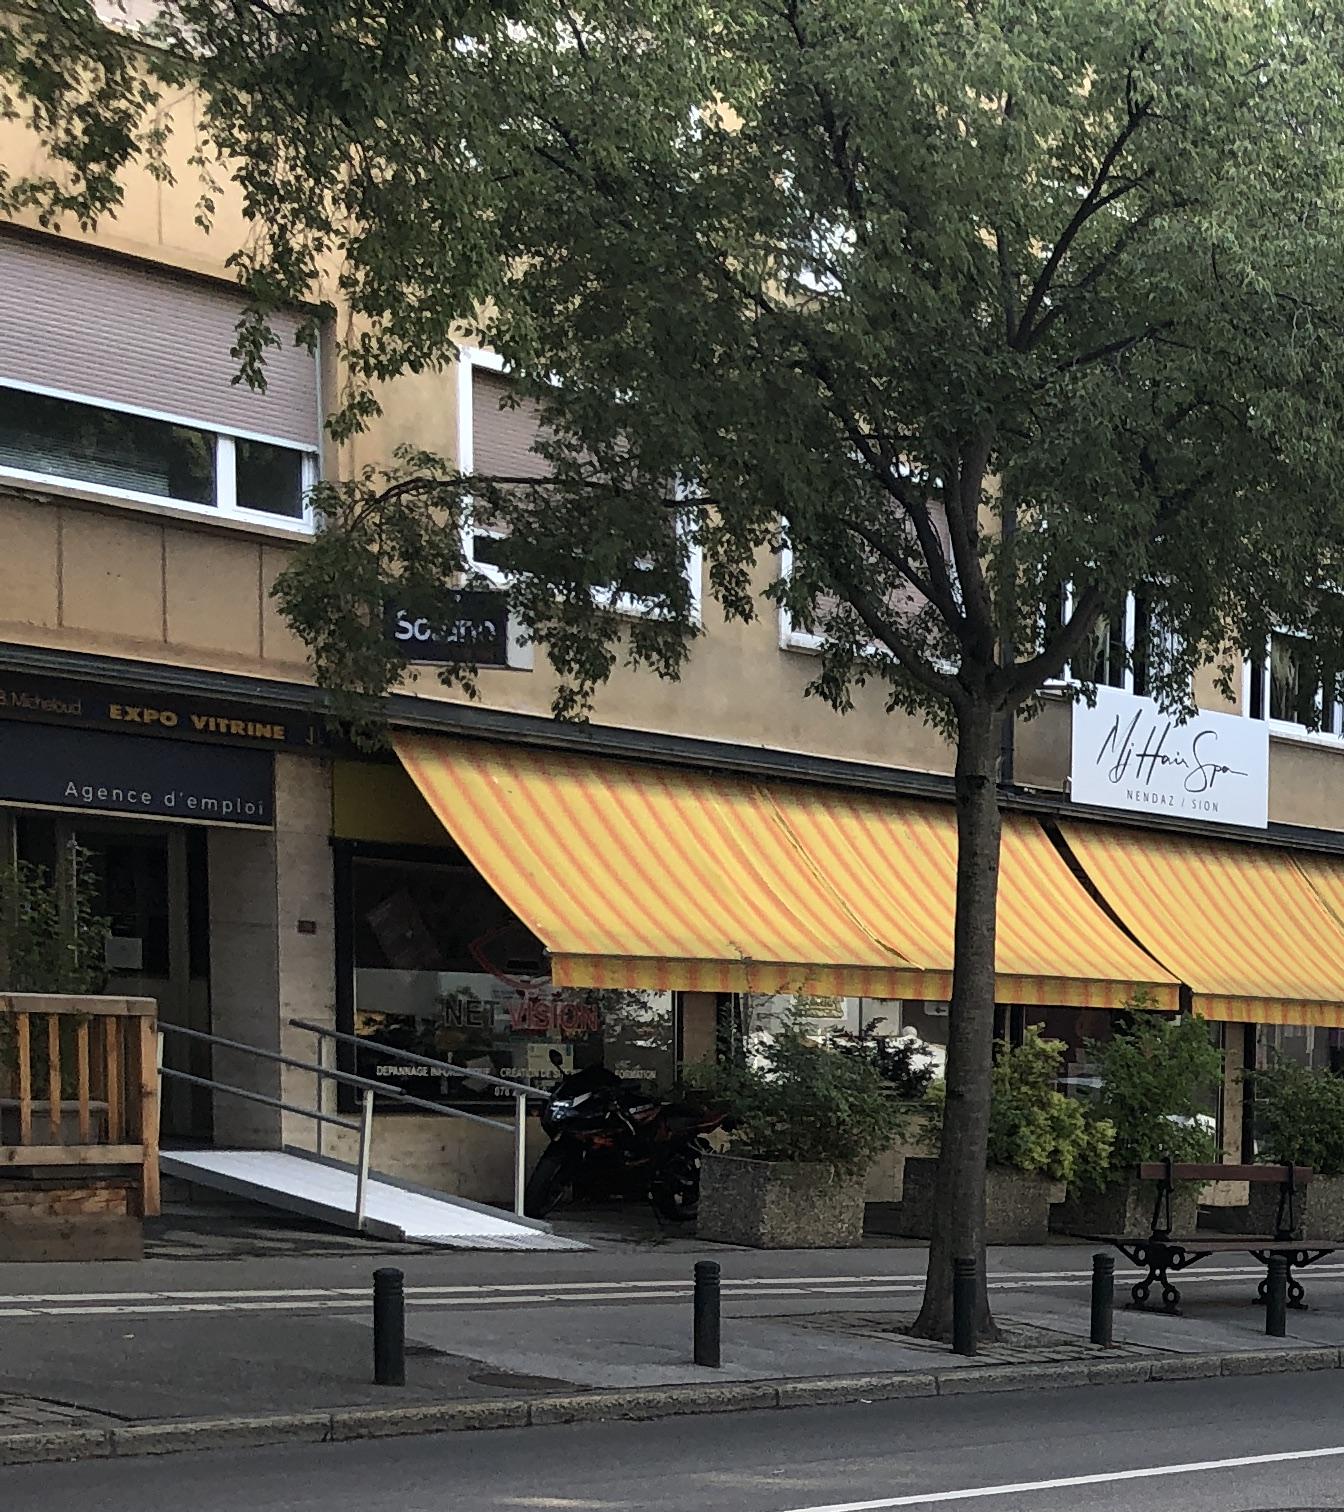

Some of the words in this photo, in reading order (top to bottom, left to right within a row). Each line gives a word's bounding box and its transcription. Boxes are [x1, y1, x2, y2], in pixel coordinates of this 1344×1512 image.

[109, 703, 178, 727] EXPO
[191, 714, 286, 740] VITRINE
[1136, 721, 1189, 785] Hair
[1184, 730, 1248, 792] Spa
[65, 781, 152, 804] Agence
[164, 791, 264, 816] d'emploi
[1126, 789, 1175, 807] NENDAZ
[1191, 799, 1220, 813] SION
[510, 1001, 600, 1032] VISION
